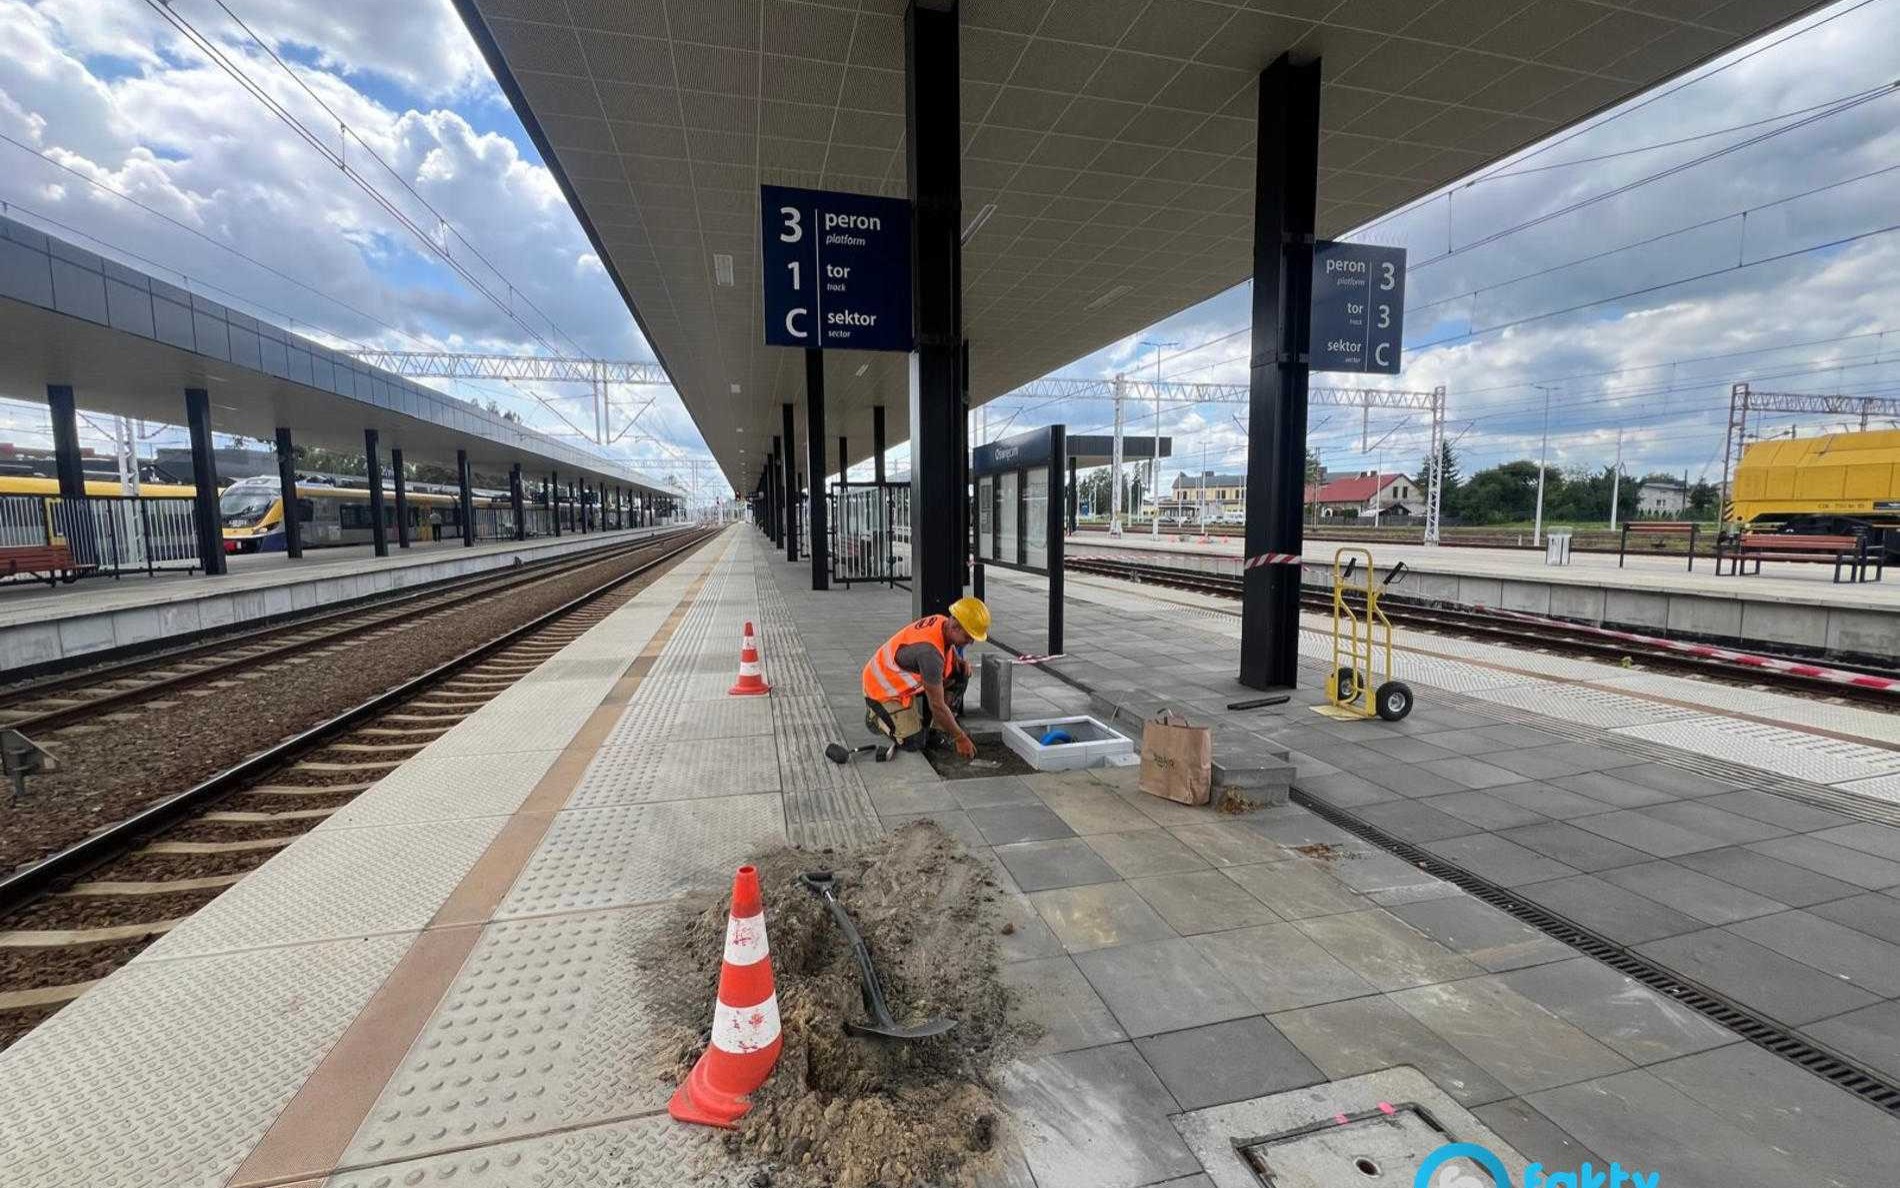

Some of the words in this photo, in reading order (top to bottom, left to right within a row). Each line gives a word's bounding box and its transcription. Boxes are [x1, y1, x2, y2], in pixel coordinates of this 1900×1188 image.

[780, 206, 803, 243] 3
[825, 212, 881, 231] peron
[826, 234, 866, 246] platform
[788, 261, 800, 290] 1
[826, 264, 851, 279] tor
[1326, 259, 1366, 274] peron
[1380, 262, 1395, 290] 3
[785, 308, 808, 338] C
[827, 309, 877, 326] sektor
[1347, 303, 1364, 314] tor
[1377, 305, 1390, 328] 3
[828, 330, 851, 338] sector
[1327, 339, 1362, 352] sektor
[1375, 342, 1390, 367] C
